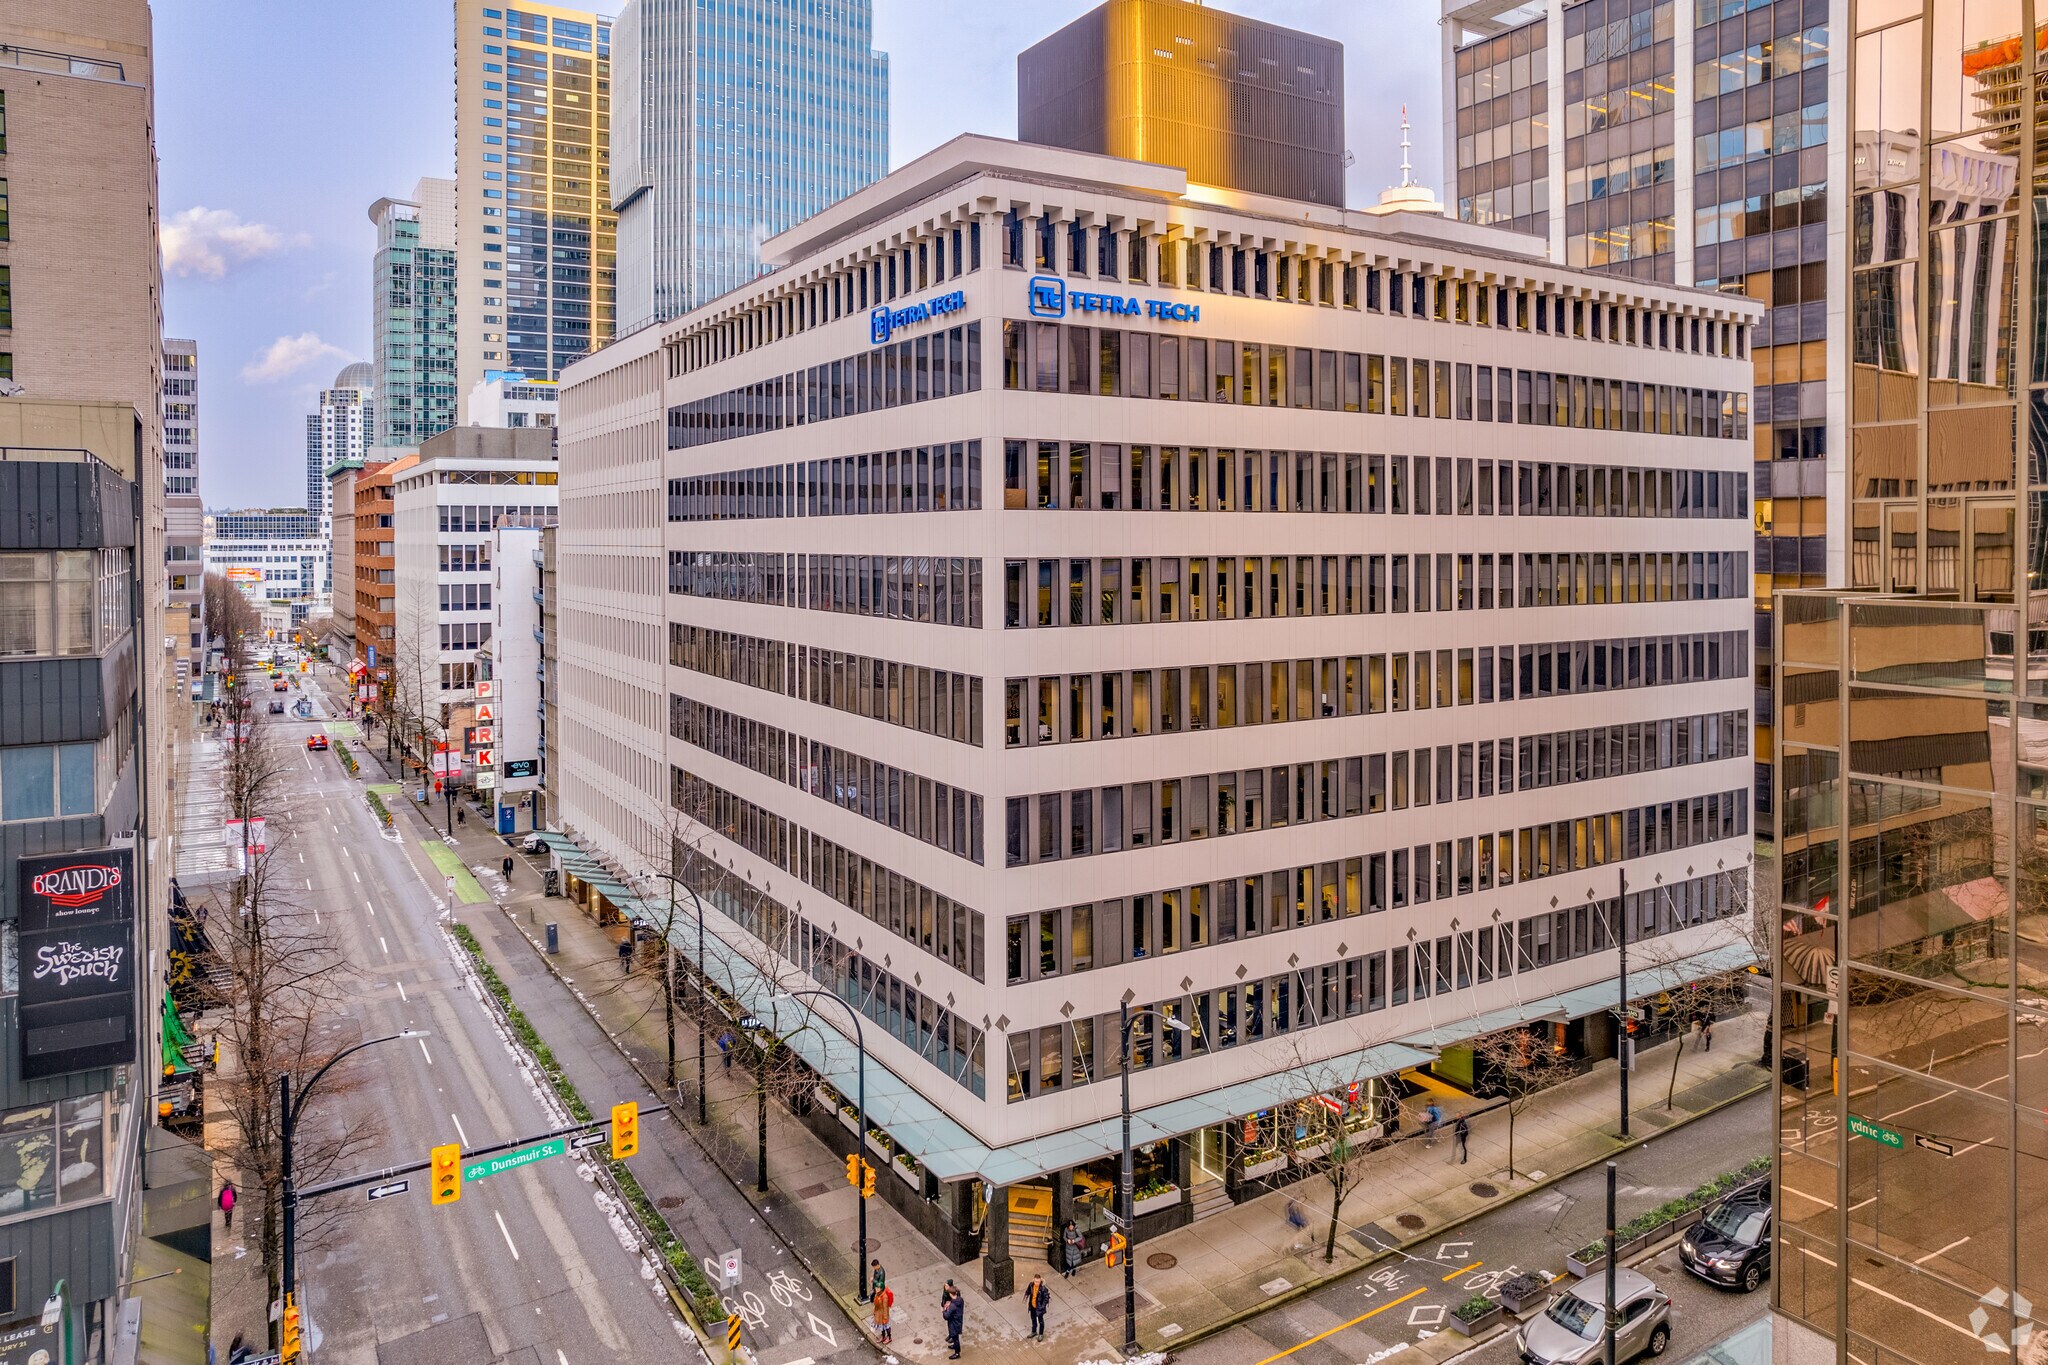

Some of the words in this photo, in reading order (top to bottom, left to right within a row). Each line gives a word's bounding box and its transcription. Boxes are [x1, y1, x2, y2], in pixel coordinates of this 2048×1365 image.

[889, 303, 929, 328] TETRA
[928, 290, 964, 316] TECH
[1068, 291, 1142, 316] TETRA
[1145, 299, 1200, 322] TECH
[477, 682, 493, 765] PARK
[511, 761, 530, 769] evo
[33, 866, 122, 896] BRANDI'S
[75, 907, 100, 915] lounge
[58, 941, 82, 954] The
[52, 960, 118, 986] Touch
[491, 1149, 541, 1171] Dunsmuir
[542, 1145, 557, 1156] St.
[4, 1328, 36, 1343] LEASE
[19, 1340, 28, 1348] 21
